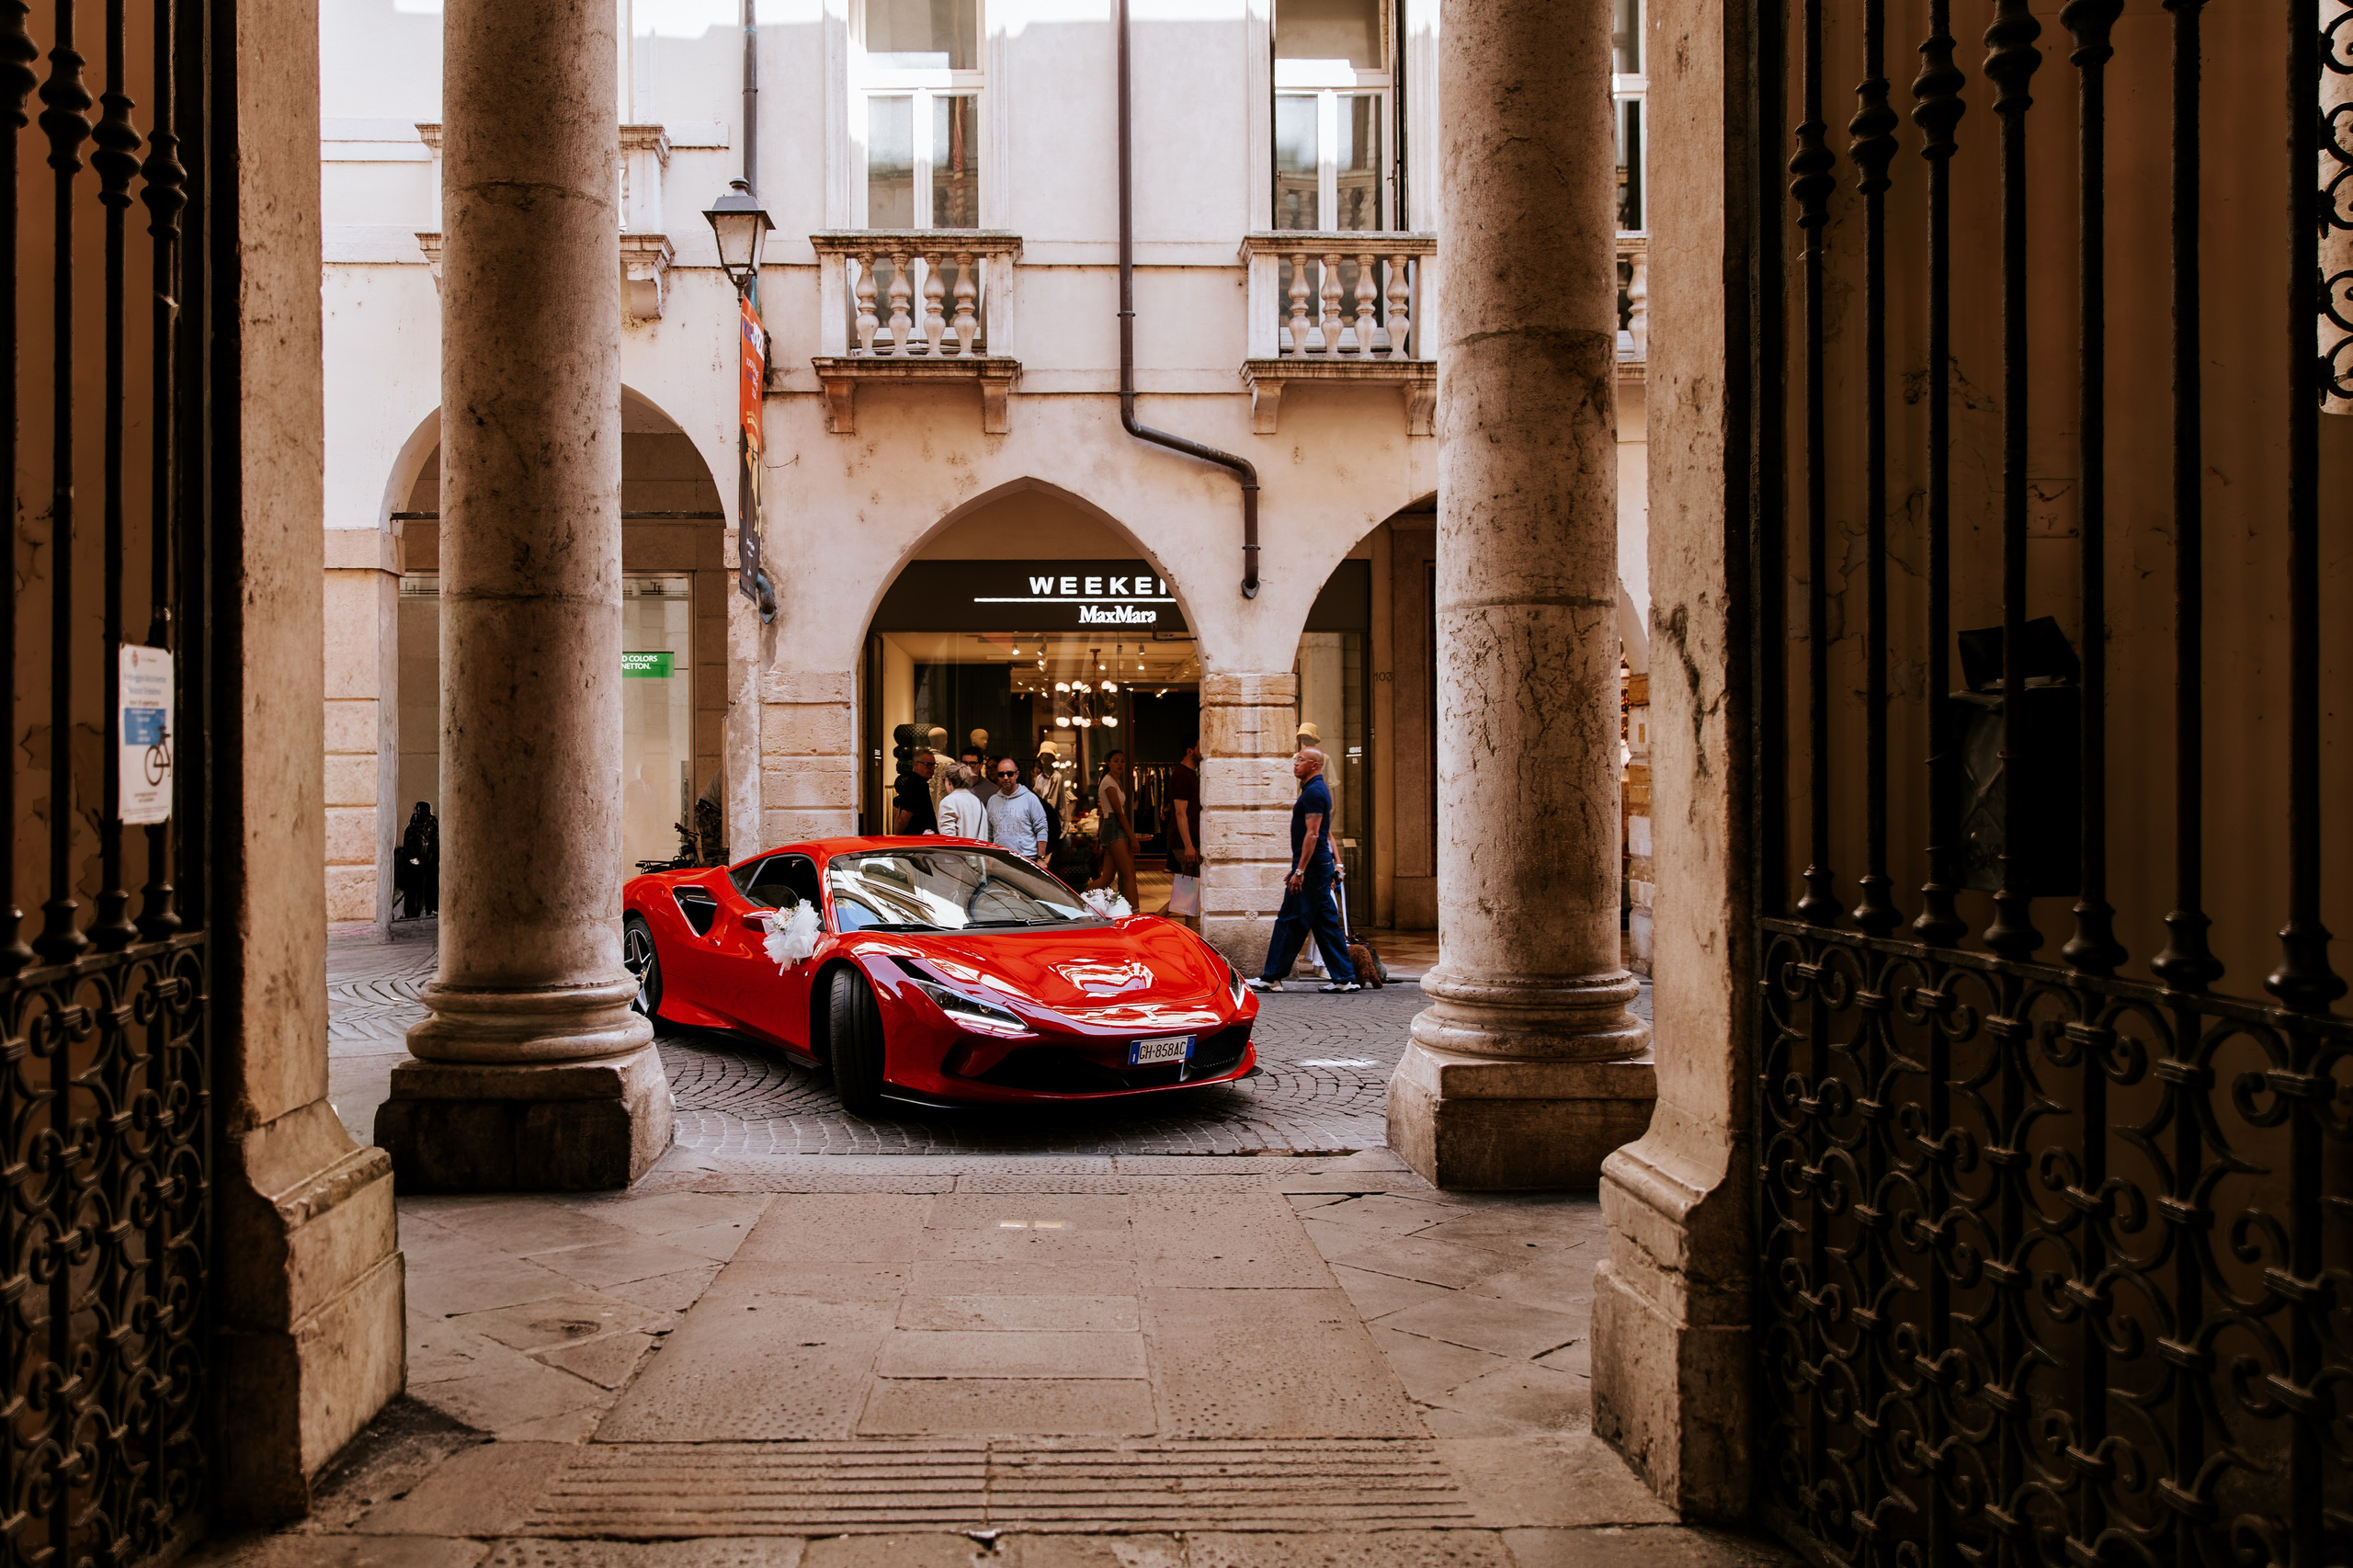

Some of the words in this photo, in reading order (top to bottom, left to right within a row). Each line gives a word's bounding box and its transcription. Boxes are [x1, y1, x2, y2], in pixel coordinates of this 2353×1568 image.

[1078, 606, 1156, 623] MaxMara
[629, 654, 658, 663] COLORS
[1373, 672, 1393, 682] 103
